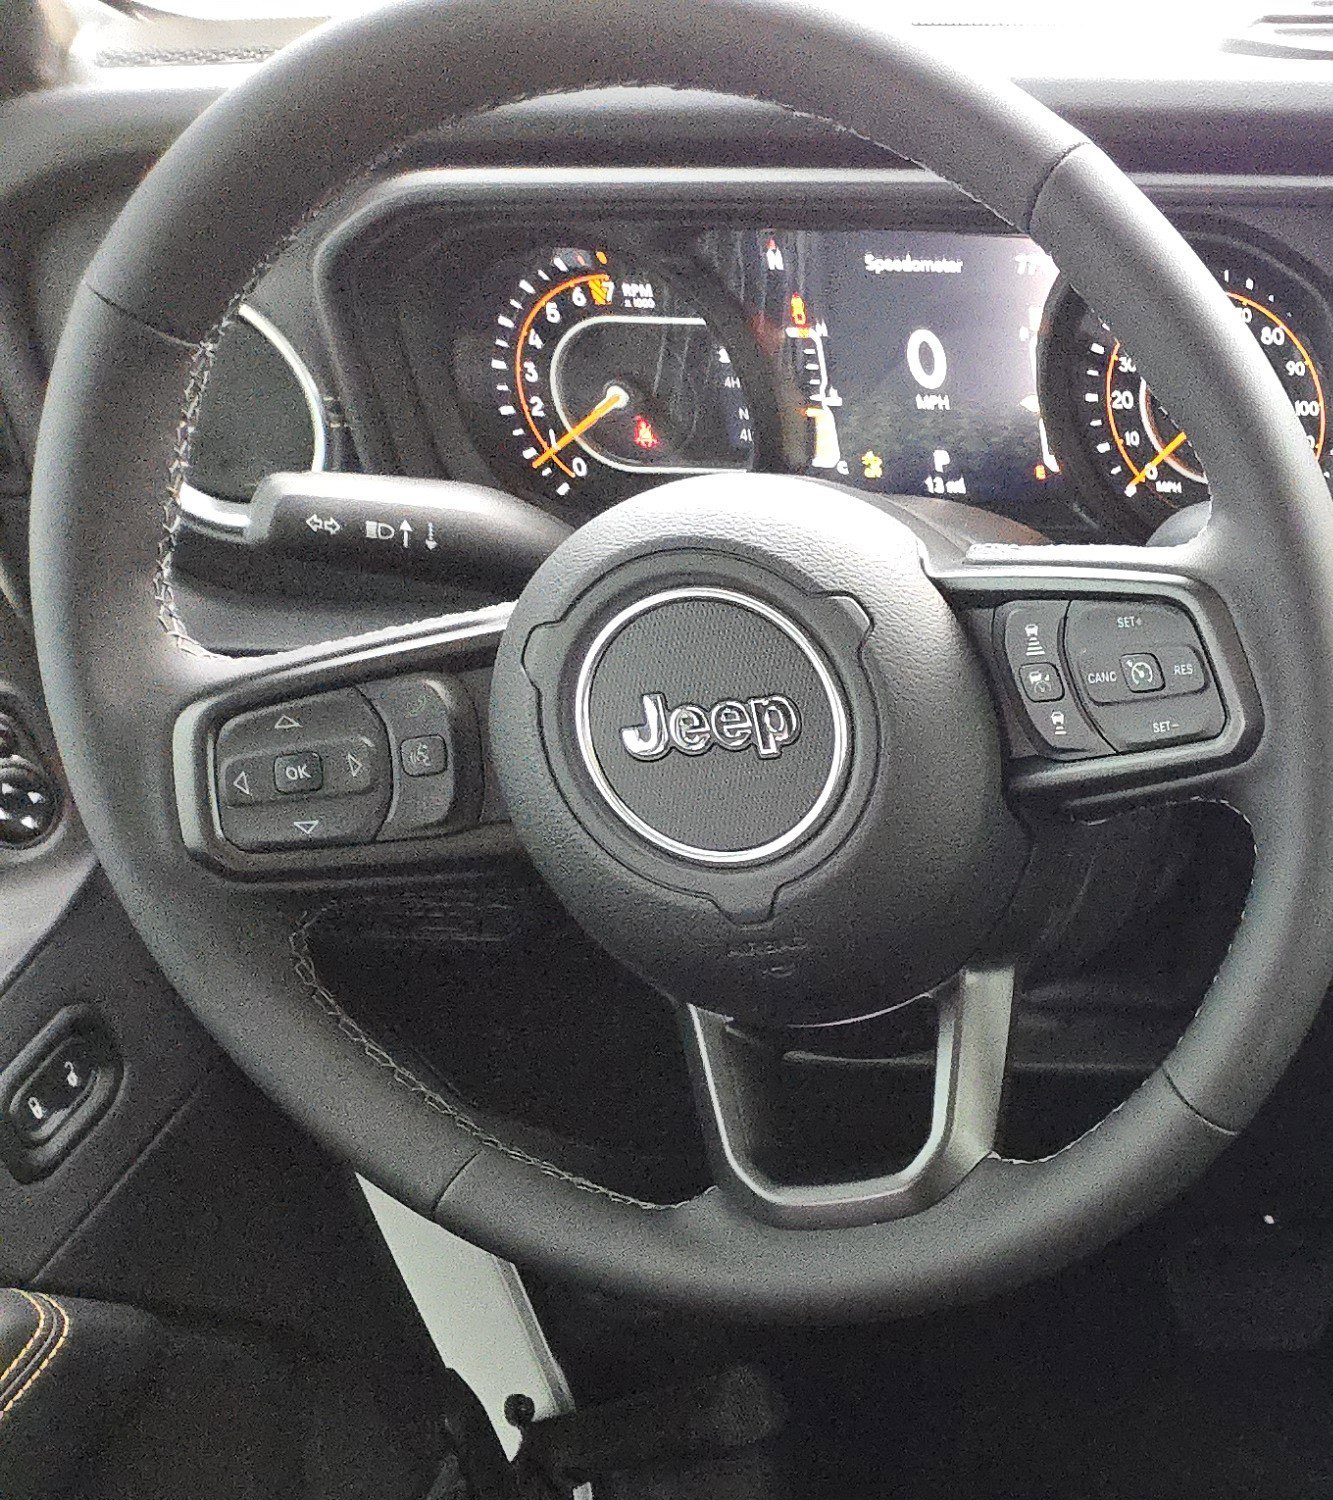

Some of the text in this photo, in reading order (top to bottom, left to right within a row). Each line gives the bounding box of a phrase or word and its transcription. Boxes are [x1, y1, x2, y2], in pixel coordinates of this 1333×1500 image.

[864, 252, 964, 274] Speedometer
[572, 286, 587, 307] 6
[602, 282, 615, 302] 7
[621, 282, 653, 297] RPM
[545, 302, 561, 323] 5
[528, 328, 544, 349] 4
[1260, 327, 1285, 345] 80
[907, 328, 947, 389] 0
[523, 361, 538, 383] 3
[1285, 361, 1305, 376] 90
[529, 396, 545, 417] 2
[915, 394, 950, 410] MPH
[1111, 390, 1133, 409] 20
[1294, 400, 1320, 416] 100
[1124, 431, 1140, 447] 10
[572, 457, 587, 477] 0
[933, 449, 950, 472] P
[925, 476, 945, 494] 13
[1087, 671, 1117, 683] CANC
[1173, 664, 1193, 675] RES
[621, 693, 799, 760] Jeep
[286, 764, 312, 780] OK
